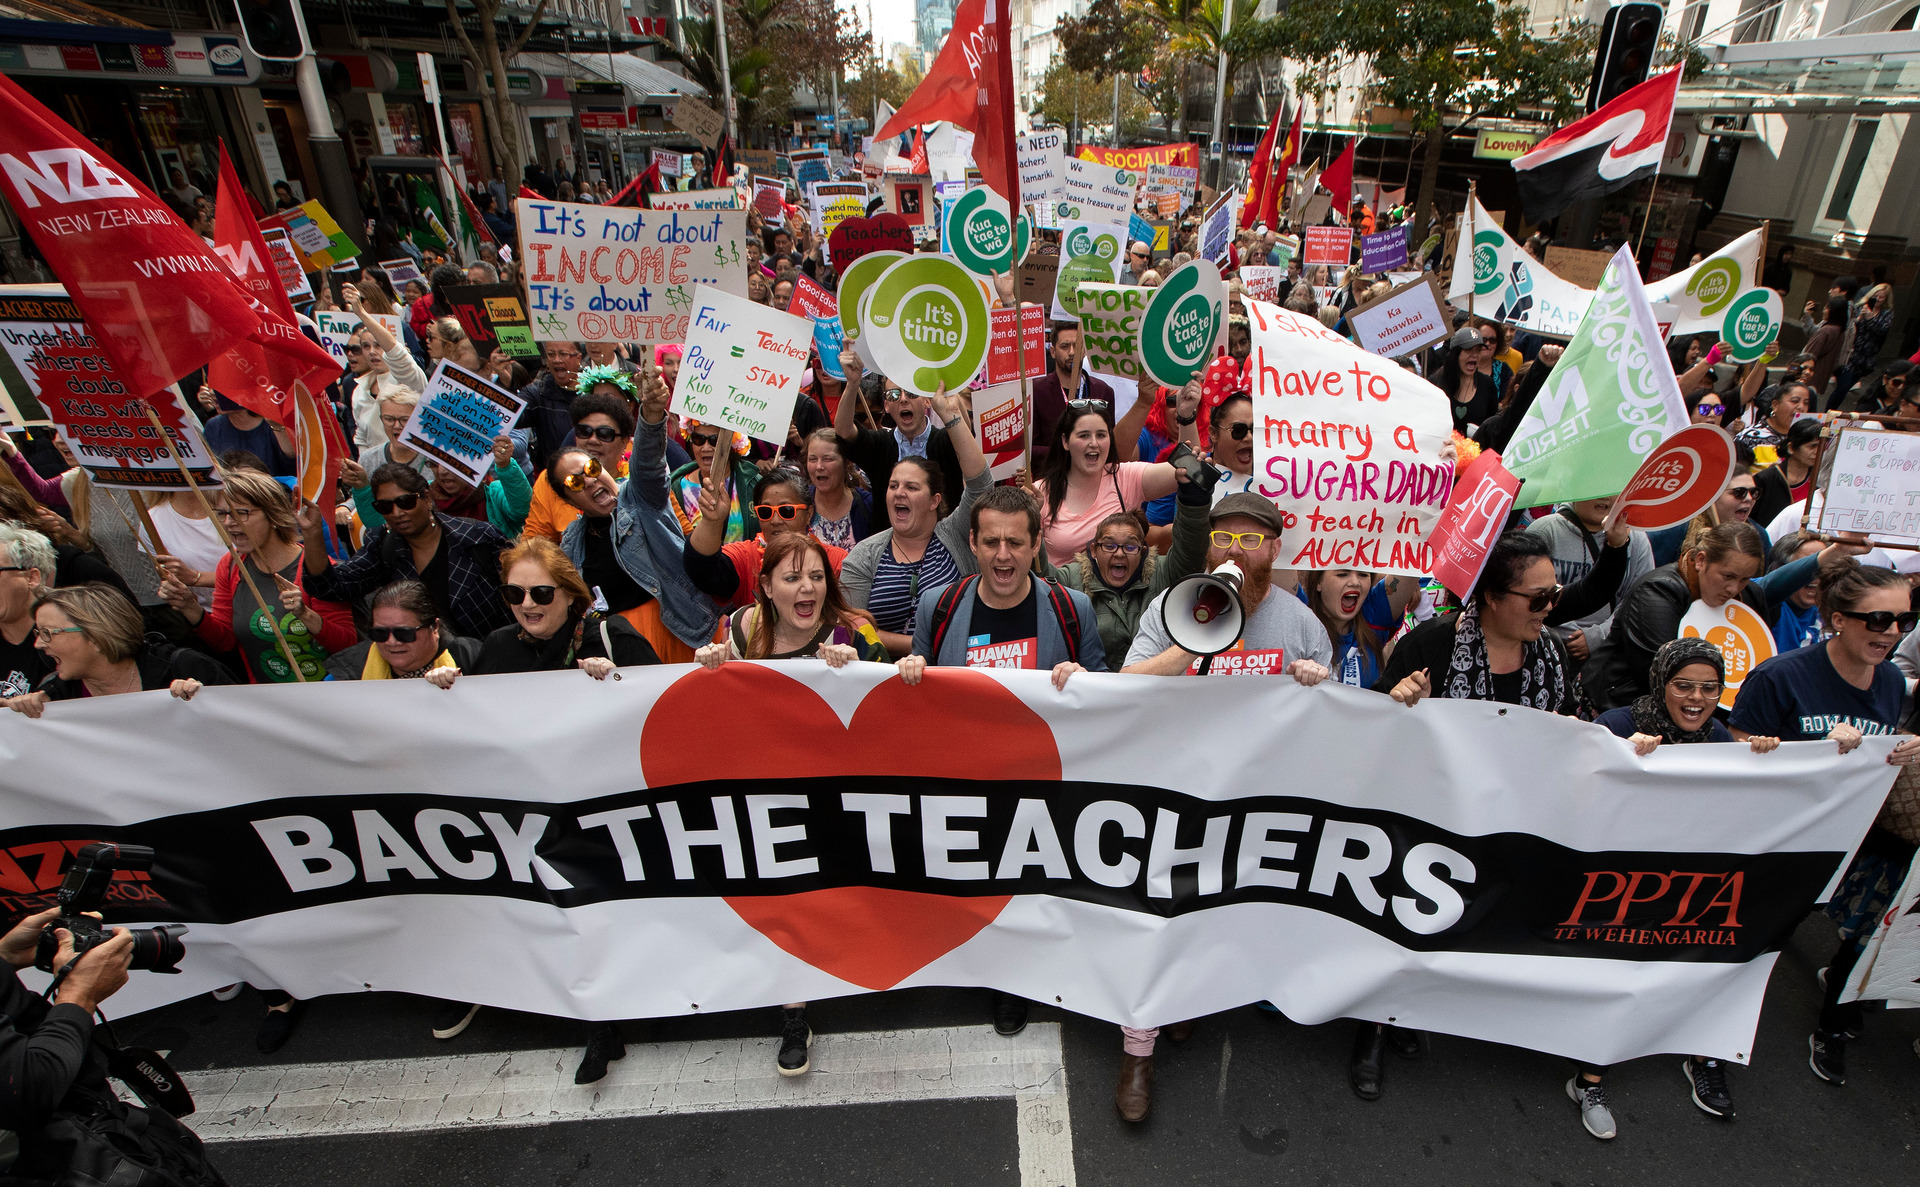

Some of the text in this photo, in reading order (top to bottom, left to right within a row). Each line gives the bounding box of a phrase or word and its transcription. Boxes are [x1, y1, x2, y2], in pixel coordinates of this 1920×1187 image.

[1029, 136, 1059, 151] NEED
[655, 152, 679, 162] VALUE
[1070, 161, 1083, 173] We
[1104, 147, 1192, 169] SOCIALIST
[1150, 165, 1198, 179] This TEACHER
[1158, 177, 1184, 187] SINGLE
[653, 195, 736, 211] We're Worried
[1022, 190, 1047, 203] future!
[820, 203, 866, 217] Spend more
[1116, 203, 1127, 212] us!
[38, 213, 92, 237] NEW
[529, 205, 723, 243] It's not about
[840, 221, 912, 243] Teachers
[968, 219, 992, 235] Kua
[995, 225, 1008, 236] te
[973, 231, 994, 244] tae
[984, 237, 1004, 253] wā
[1363, 239, 1406, 256] Education Cuts
[1366, 229, 1403, 246] Time to Heal
[1311, 245, 1345, 253] them NOW!
[1477, 248, 1491, 267] Kua
[1247, 277, 1265, 288] MAKE
[1709, 280, 1723, 292] It's
[529, 285, 653, 312] It's about
[798, 279, 839, 312] Good Educ
[1698, 287, 1725, 300] time
[0, 300, 83, 319] EACHER STRU
[799, 298, 820, 316] needs
[926, 302, 953, 327] It's
[1251, 302, 1267, 331] I
[1387, 307, 1402, 321] Ka
[318, 314, 353, 335] FAIR
[1079, 313, 1140, 334] TEAC
[1170, 309, 1197, 331] Kua
[1200, 317, 1209, 331] te
[1377, 312, 1423, 340] whawhai
[1741, 312, 1760, 324] Kua
[1742, 323, 1766, 334] tae te
[1, 328, 98, 353] Underfun
[904, 318, 957, 347] time
[1008, 324, 1044, 338] do need
[1175, 327, 1197, 345] tae
[1377, 323, 1434, 356] tonu mātou
[1743, 332, 1758, 345] wā
[757, 330, 808, 361] Teachers
[995, 345, 1013, 355] them
[1185, 334, 1203, 355] wā
[32, 350, 113, 374] there's
[686, 345, 716, 380] Pay
[1090, 354, 1143, 376] MO
[225, 349, 288, 406] zei.org
[746, 365, 791, 390] STAY
[995, 372, 1017, 382] Auckland
[1258, 346, 1391, 401] have to
[446, 367, 517, 409] TEACHER STRUGGLES
[686, 374, 768, 411] Kuo Taimi
[61, 398, 108, 419] Kids
[437, 377, 513, 424] I'm not walking
[441, 392, 501, 429] out on my
[683, 394, 708, 416] Kuo
[439, 403, 489, 435] students
[983, 402, 1013, 421] TEACHERS
[70, 421, 134, 441] needs
[421, 408, 494, 454] I'm walking
[985, 416, 1016, 438] BRING
[423, 422, 447, 439] for
[448, 434, 482, 460] them
[988, 432, 1011, 448] THE
[1264, 414, 1420, 462] marry a
[1845, 435, 1900, 454] MORE
[78, 443, 154, 467] missing
[1651, 459, 1685, 477] It's
[1258, 460, 1455, 511] SUGAR DADDY
[1835, 472, 1881, 489] MORE
[1857, 489, 1897, 506] TIME
[1306, 510, 1420, 541] teach in
[1290, 541, 1435, 579] AUCKLAND
[1723, 631, 1736, 647] te
[965, 641, 1028, 664] PUAWAI
[1245, 653, 1280, 668] OUT
[1734, 648, 1747, 672] wā
[249, 792, 1477, 935] BACK THE TEACHERS
[1557, 869, 1744, 928] PPTA
[1553, 927, 1737, 945] TE WEHENGARUA
[136, 1060, 173, 1094] Canon
